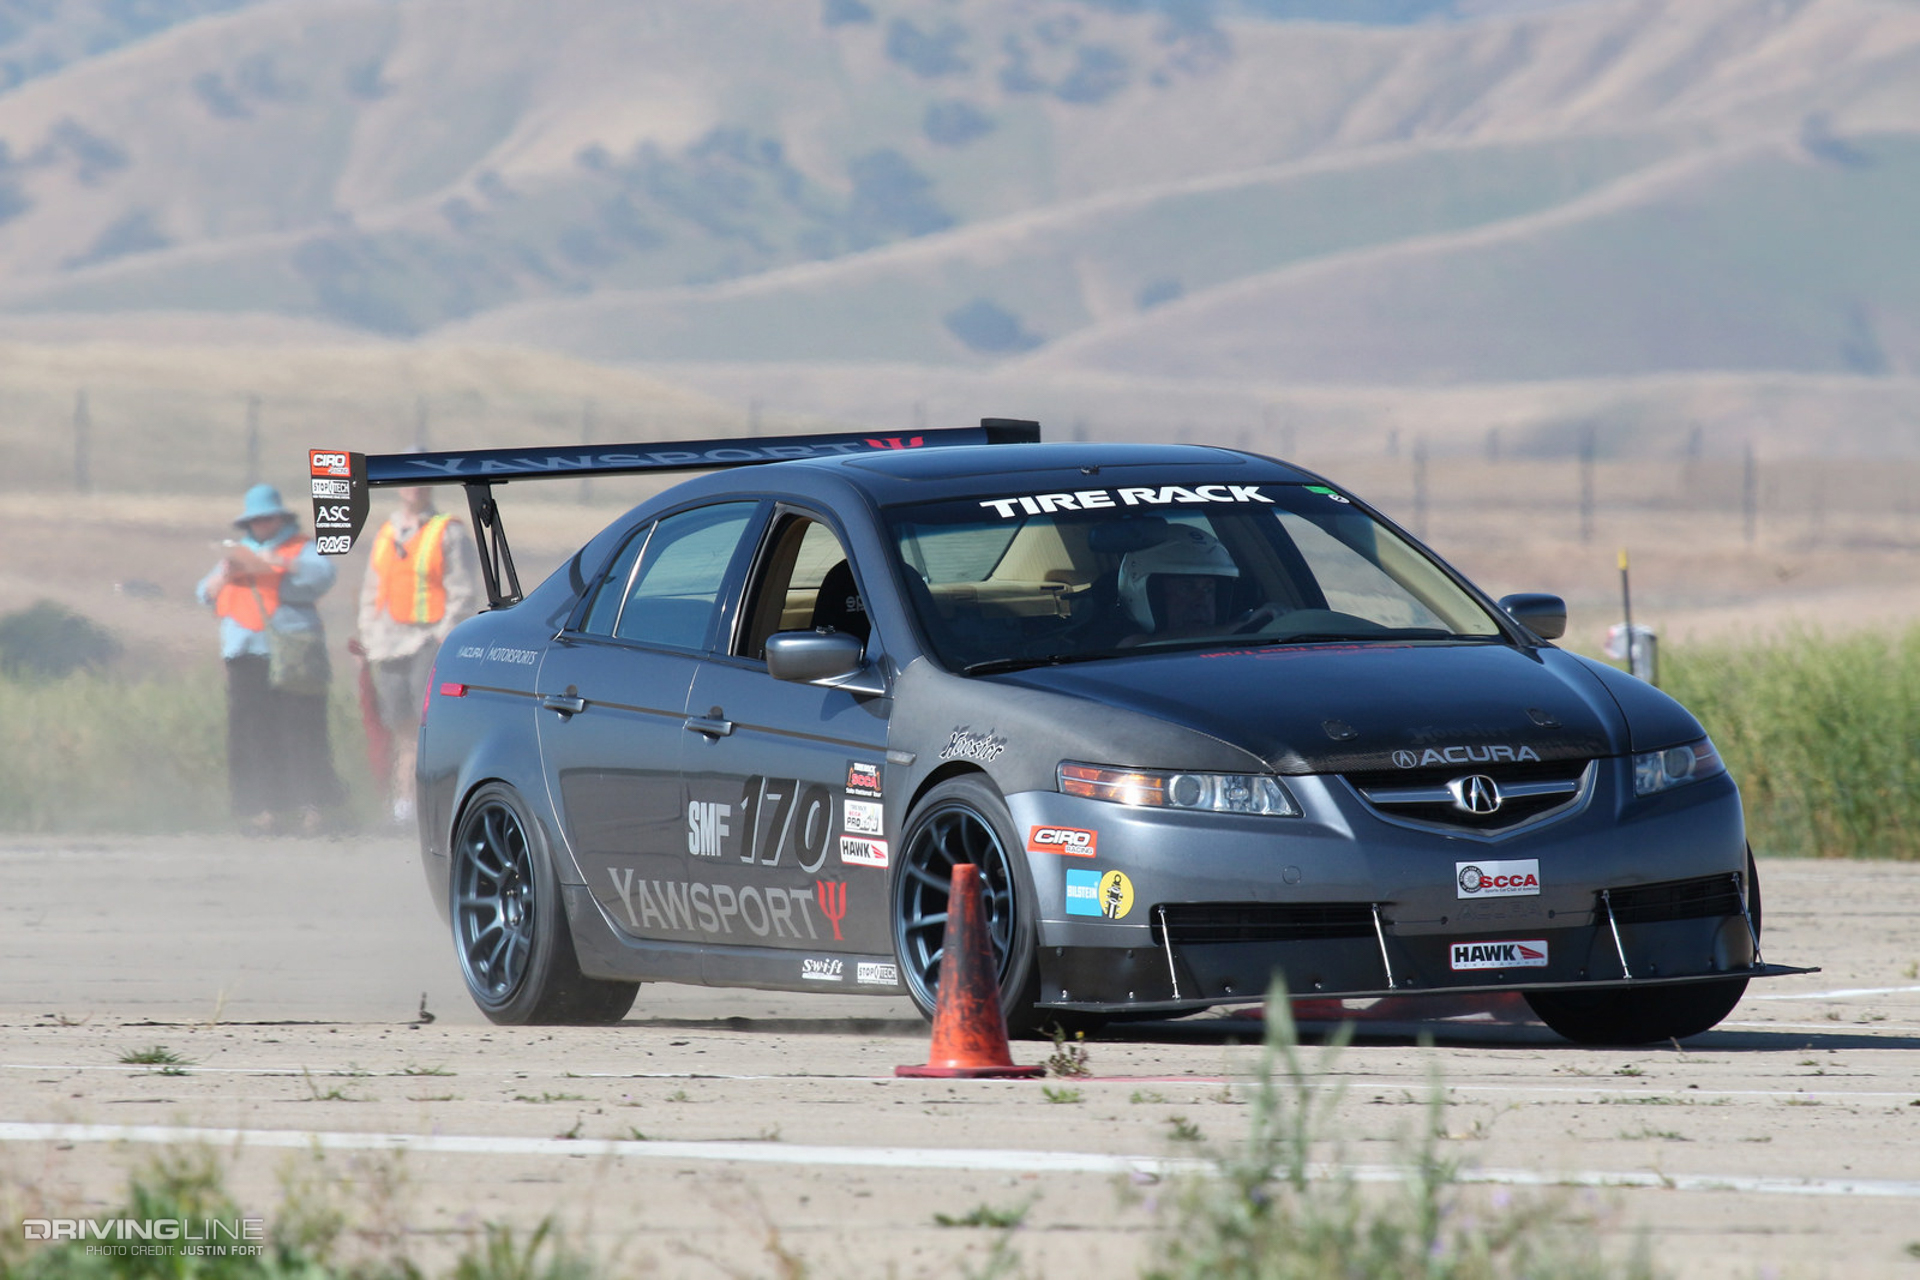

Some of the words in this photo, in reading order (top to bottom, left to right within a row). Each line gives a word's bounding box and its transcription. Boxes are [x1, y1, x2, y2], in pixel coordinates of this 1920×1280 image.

[313, 454, 346, 467] CIRO
[406, 442, 860, 474] YAWSPORT
[980, 490, 1115, 518] TIRE
[1117, 485, 1276, 506] RACK
[316, 505, 350, 522] ASC
[317, 535, 351, 553] RAYS
[939, 730, 1006, 762] Hoosier
[1420, 745, 1541, 766] ACURA
[851, 773, 878, 788] SCCA
[688, 800, 732, 857] SMF
[740, 774, 833, 873] 170
[1034, 828, 1091, 847] CIRO
[842, 840, 871, 858] HAWK
[1066, 845, 1094, 855] RACING
[1478, 873, 1539, 888] SCCA
[1067, 885, 1098, 899] BILSTEIN
[607, 867, 819, 940] YAWSPORT
[1454, 944, 1517, 963] HAWK
[802, 958, 843, 975] Swift
